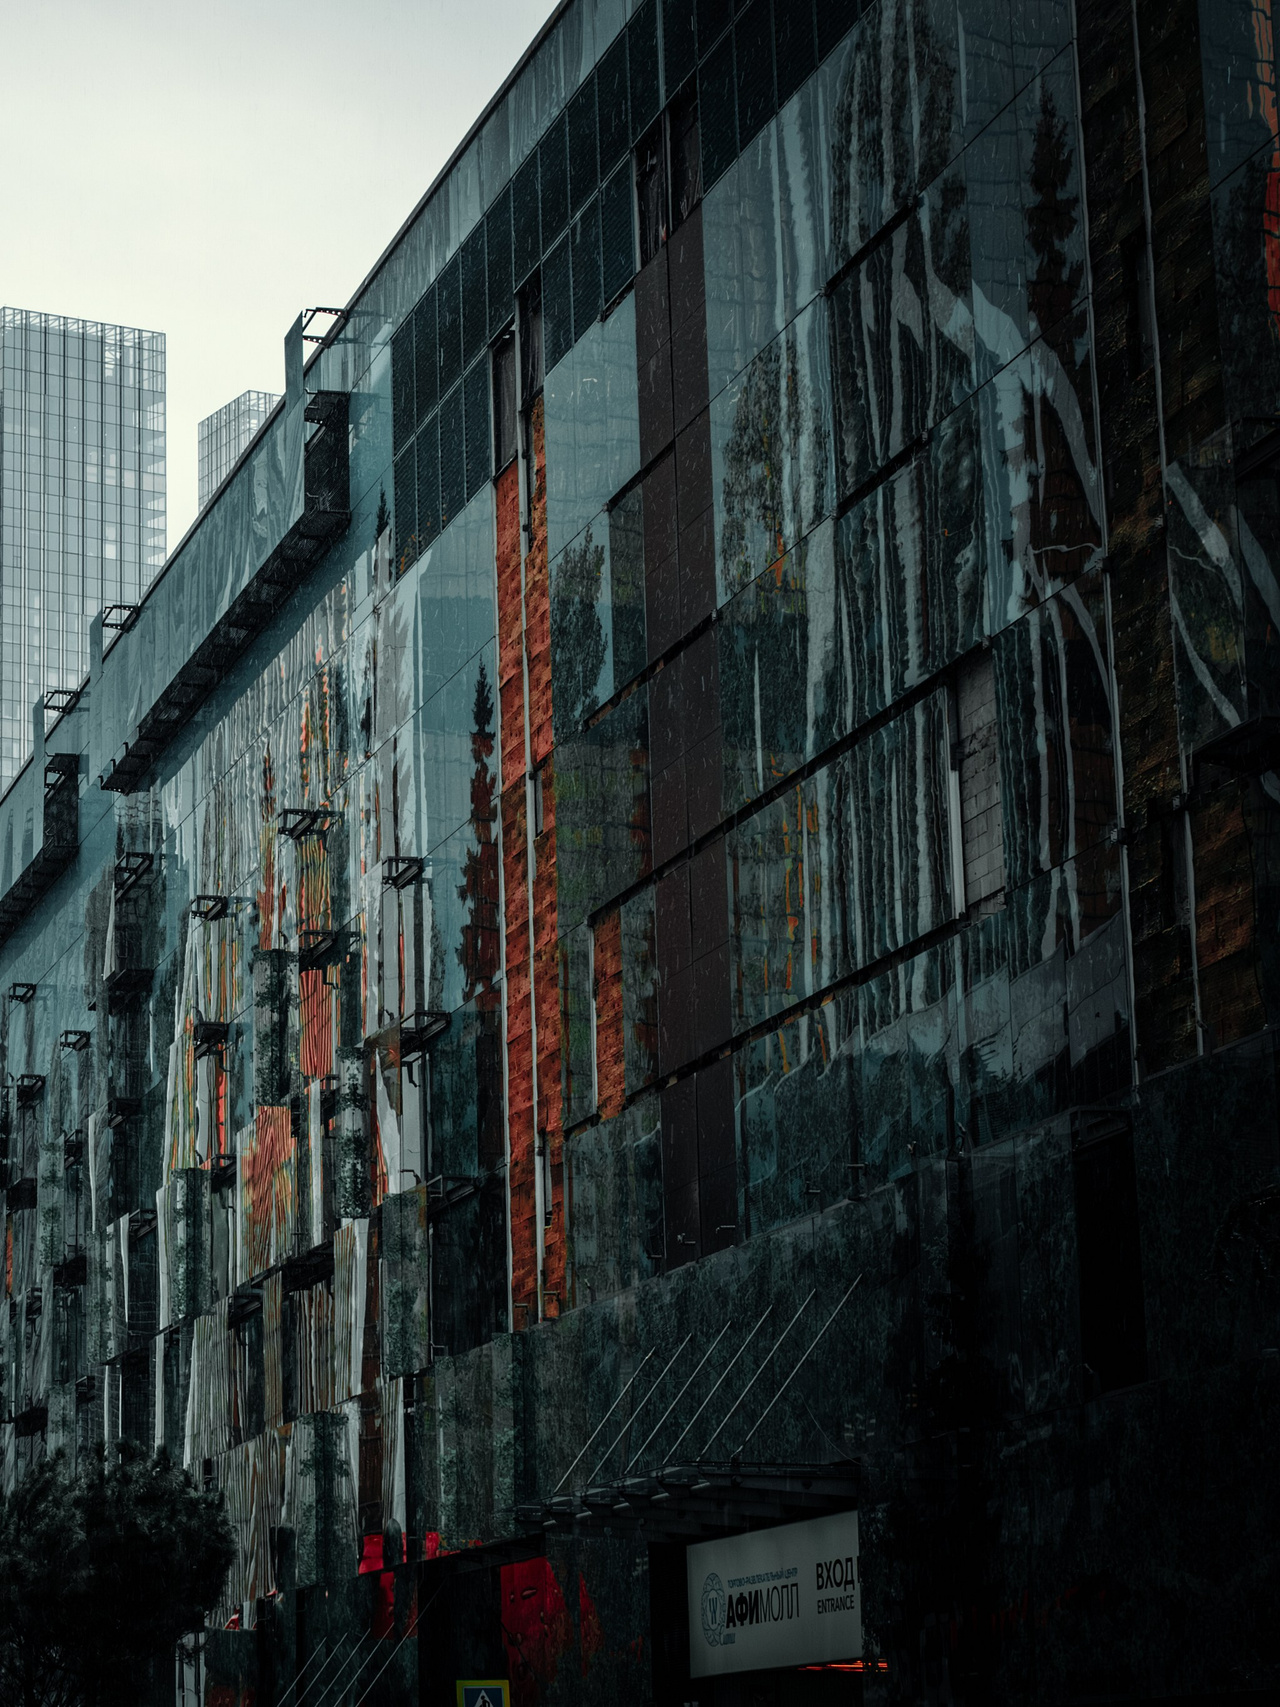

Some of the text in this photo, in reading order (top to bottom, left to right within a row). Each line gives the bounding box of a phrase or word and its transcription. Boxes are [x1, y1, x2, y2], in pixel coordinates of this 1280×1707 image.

[816, 1557, 855, 1591] ВХОД
[726, 1583, 800, 1629] АФИМОЛЛ
[817, 1594, 855, 1614] ENTRANCE
